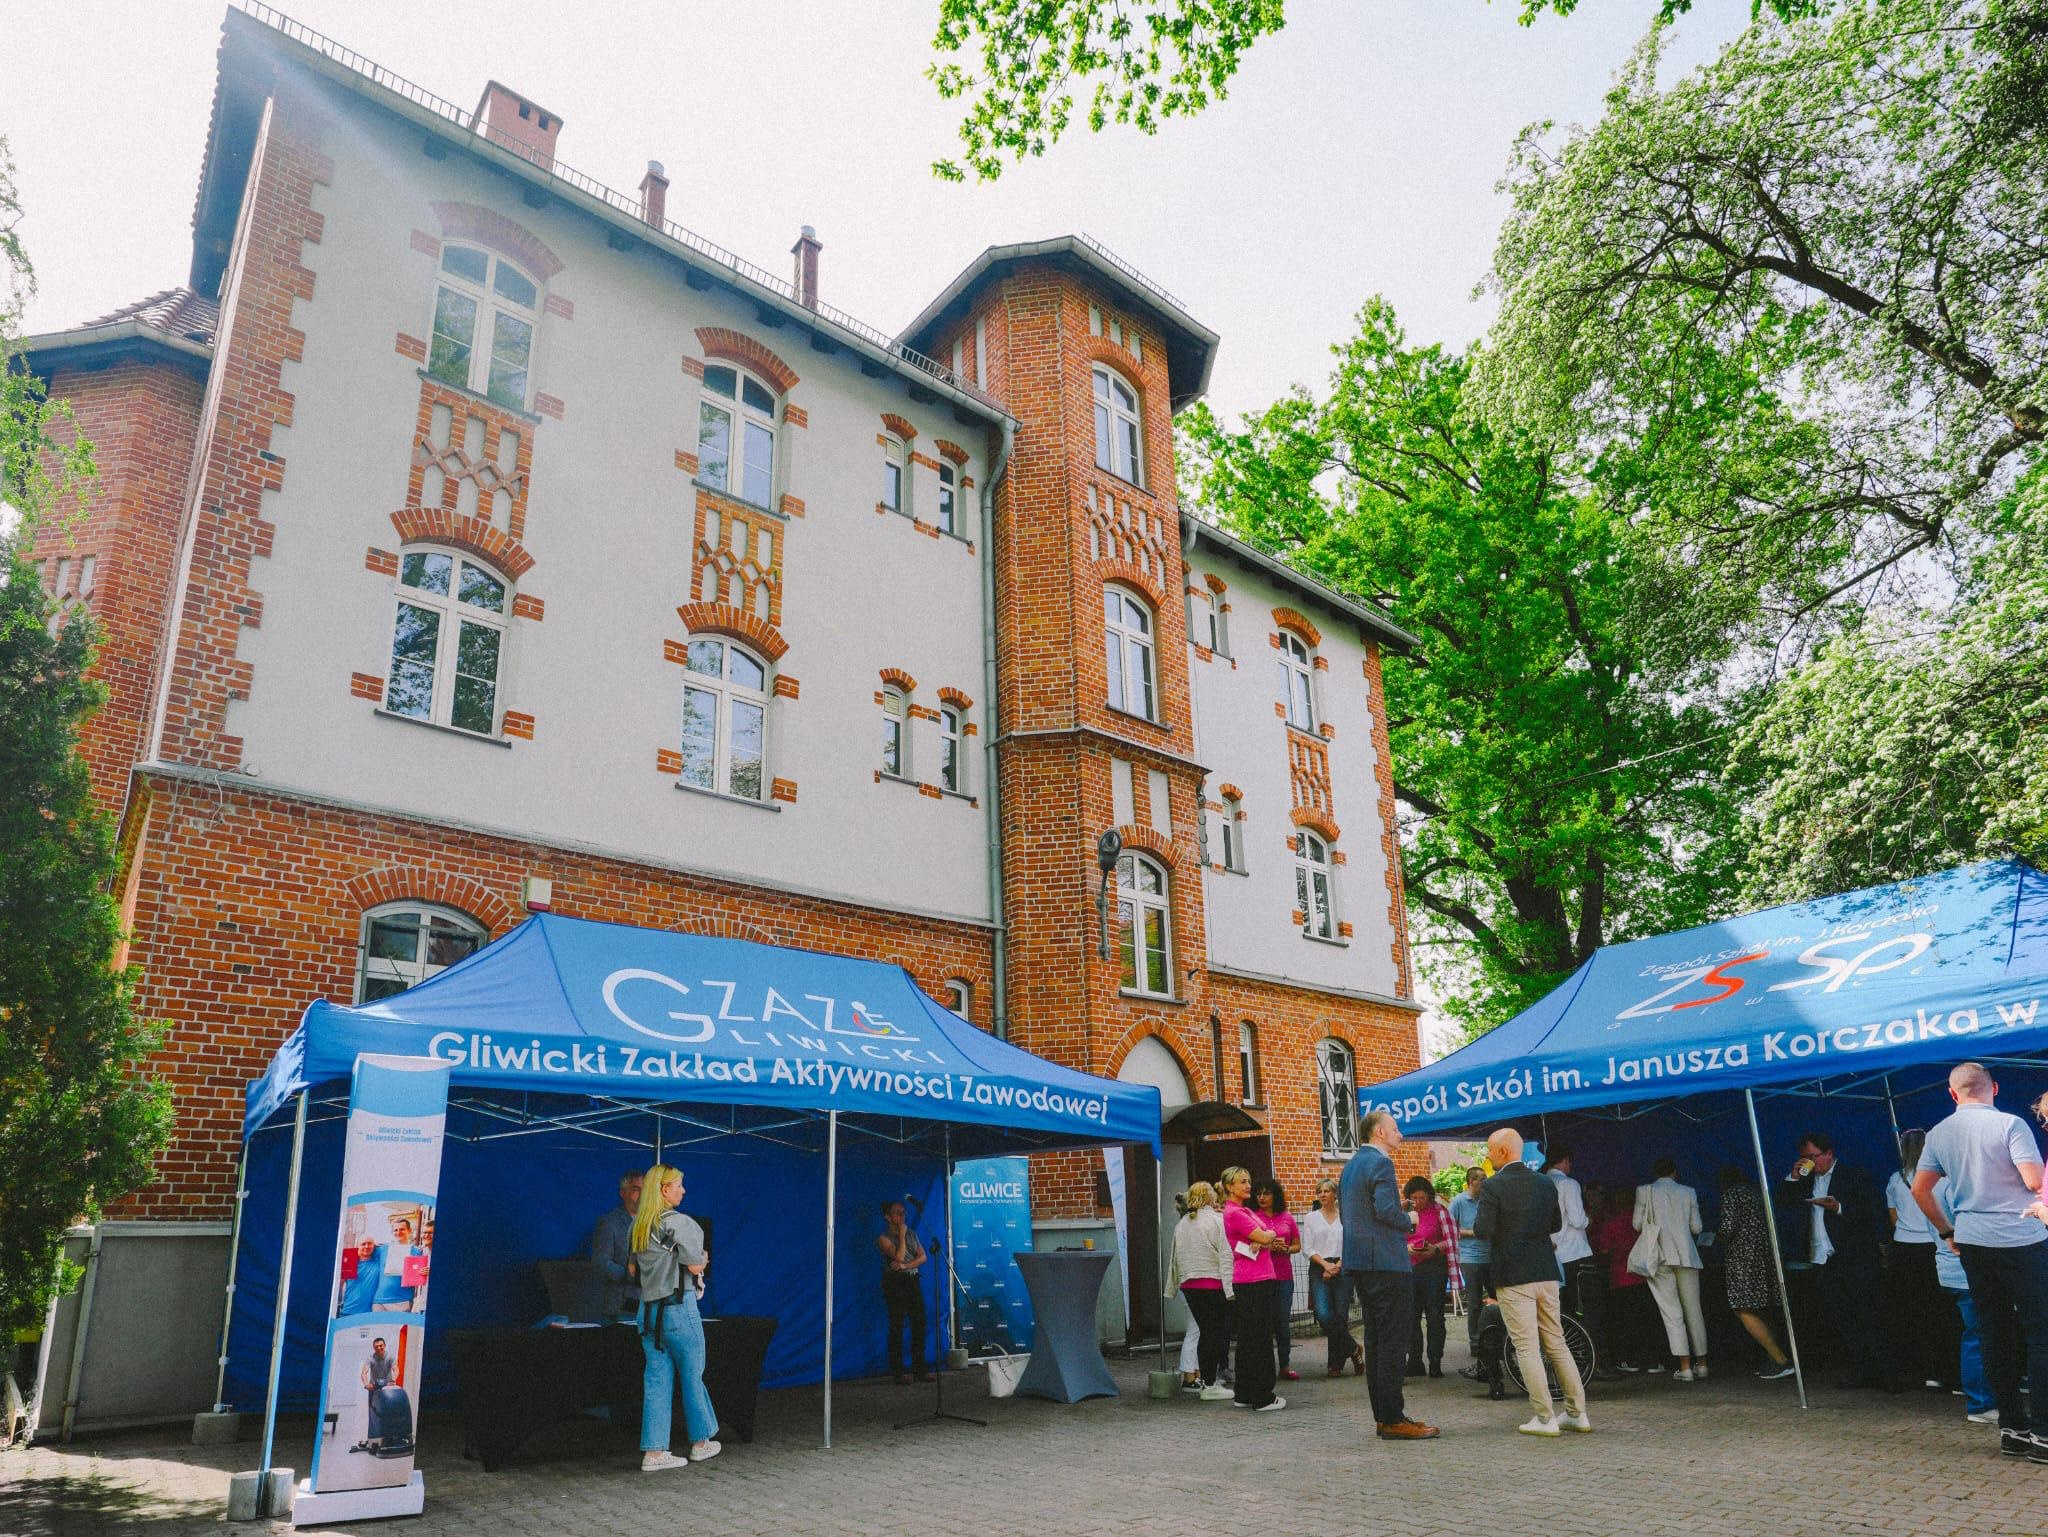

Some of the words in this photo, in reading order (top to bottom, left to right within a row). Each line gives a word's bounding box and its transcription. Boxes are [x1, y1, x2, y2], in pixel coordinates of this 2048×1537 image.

[428, 1031, 607, 1074] Gliwicki
[619, 1047, 758, 1083] Zakład
[770, 1057, 953, 1101] Aktywności
[958, 1075, 1109, 1125] Zawodowej
[1457, 1069, 1532, 1108] Szkół
[1542, 1066, 1590, 1094] im.
[1601, 1043, 1749, 1085] Janusza
[1764, 1008, 1980, 1062] Korczaka
[1995, 999, 2041, 1029] w
[960, 1182, 1022, 1198] GLIWICE
